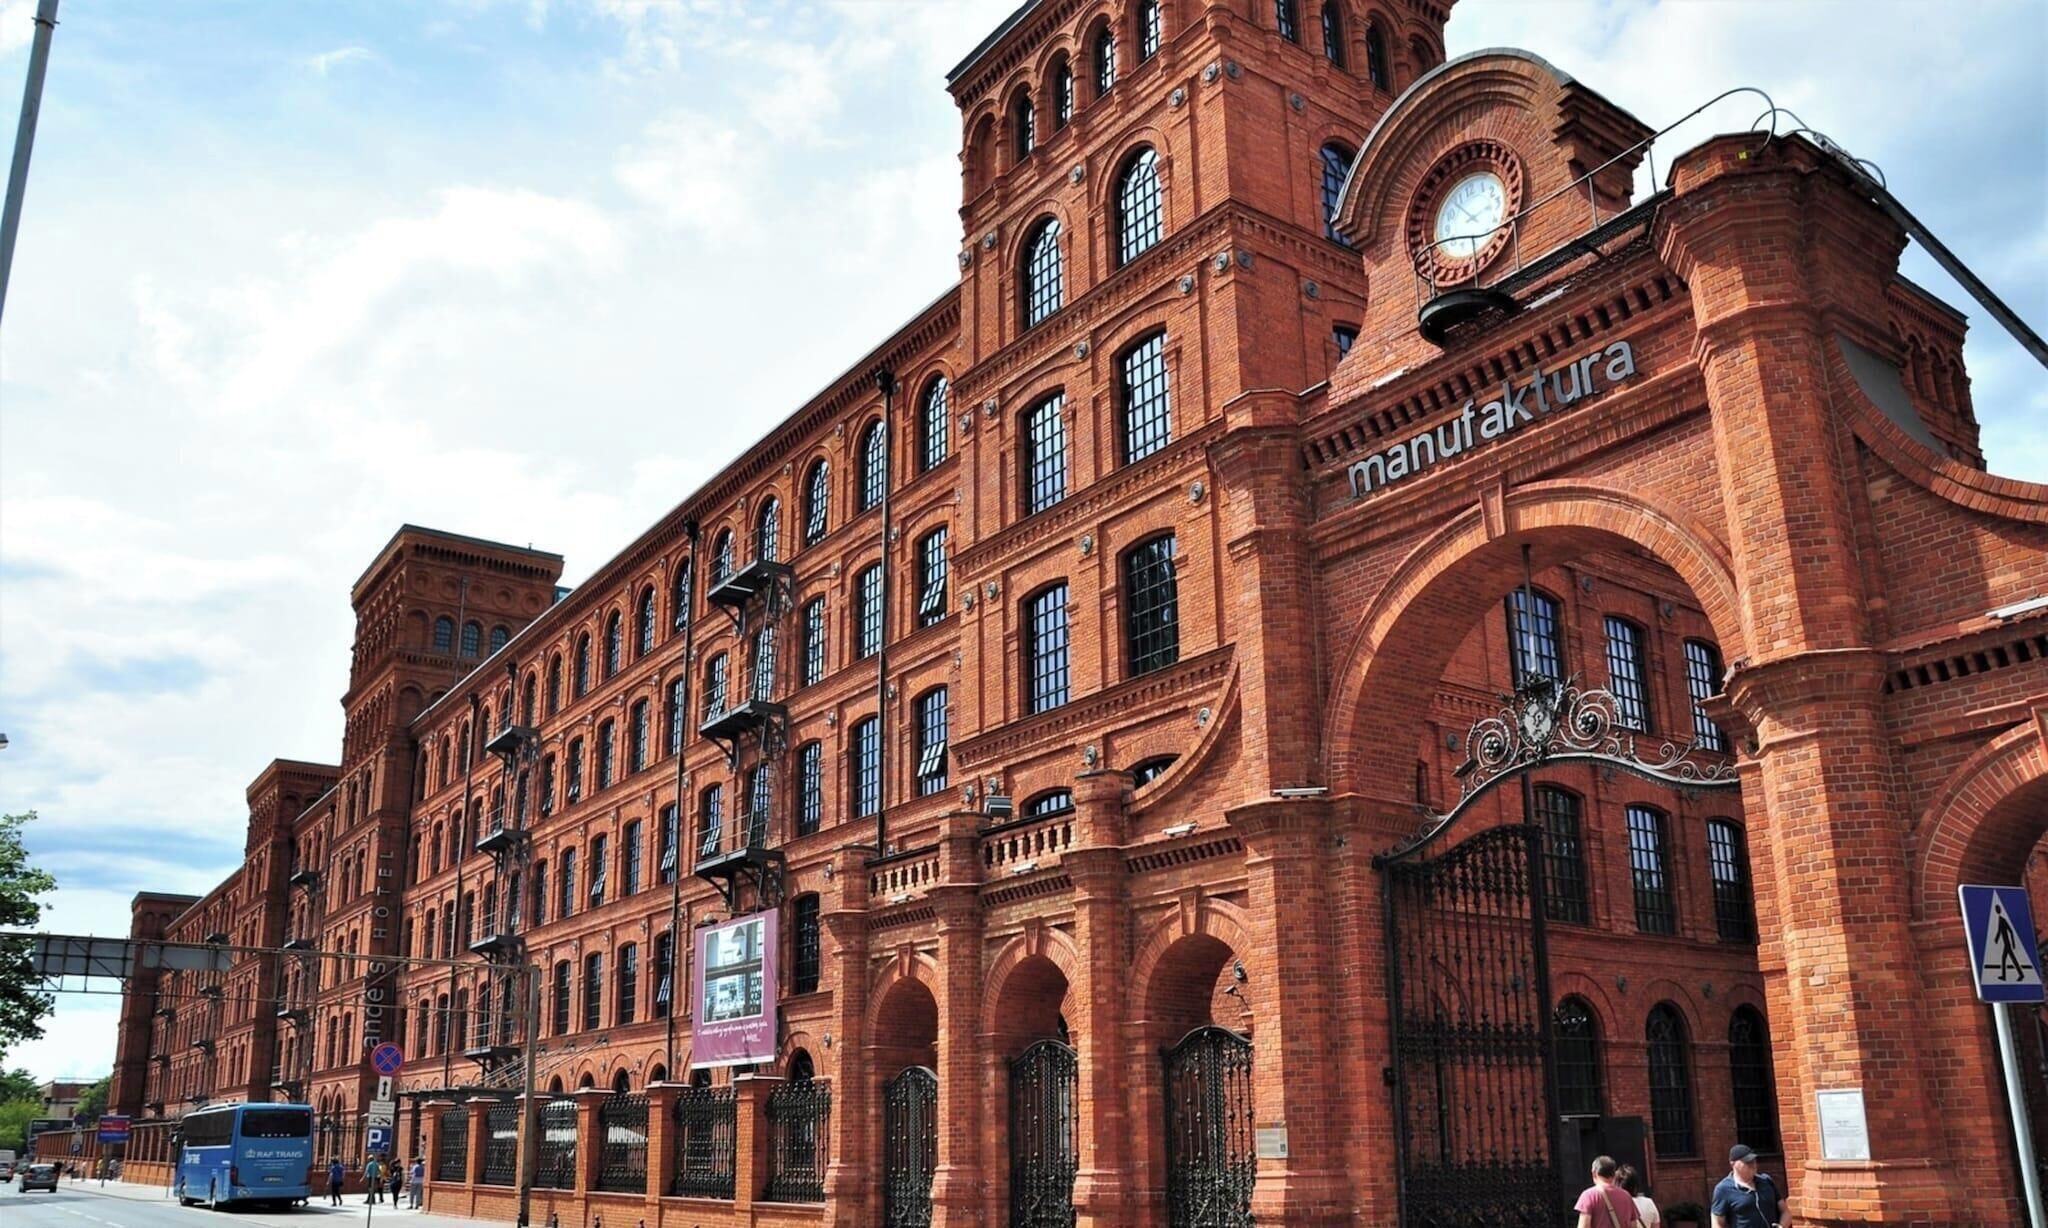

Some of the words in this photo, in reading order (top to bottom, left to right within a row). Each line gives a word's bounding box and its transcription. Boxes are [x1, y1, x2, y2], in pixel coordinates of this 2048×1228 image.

[1347, 340, 1637, 497] manufaktura
[373, 850, 394, 939] HOTEL
[367, 1129, 382, 1148] P
